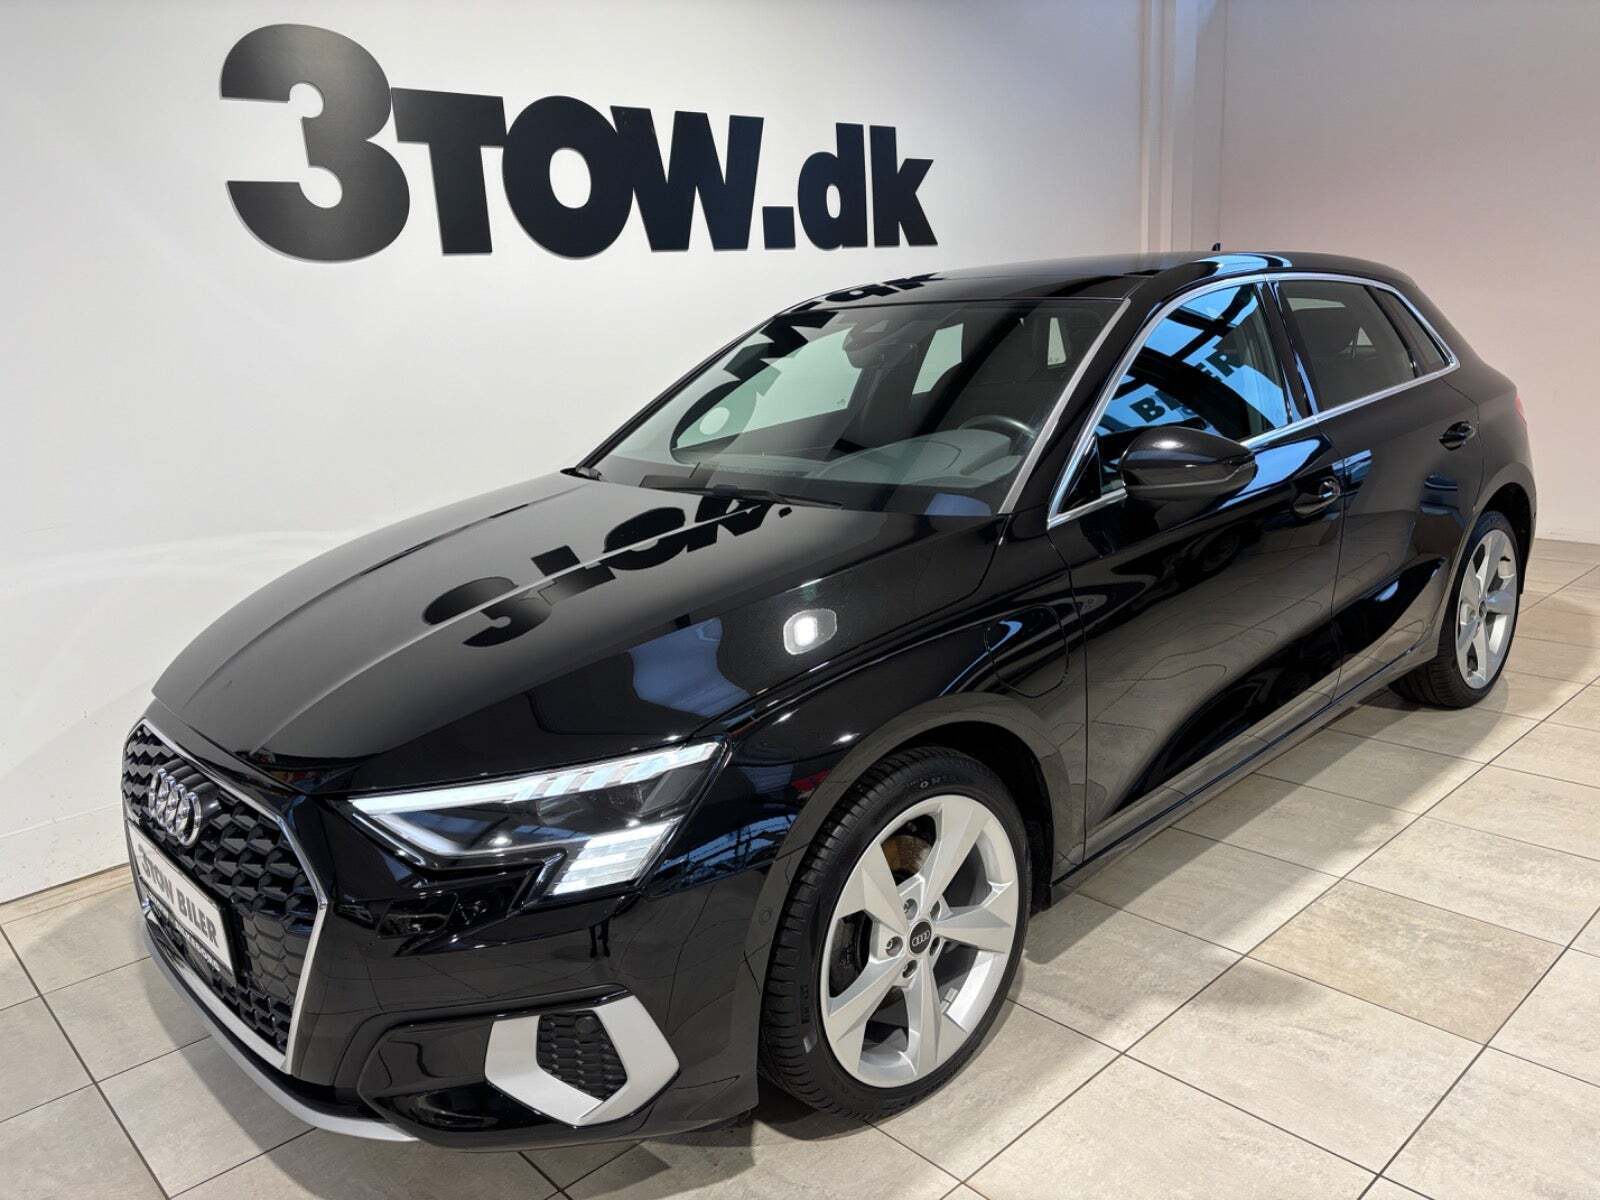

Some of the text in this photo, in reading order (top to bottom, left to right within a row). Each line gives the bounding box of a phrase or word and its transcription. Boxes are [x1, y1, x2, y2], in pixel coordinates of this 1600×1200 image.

[220, 23, 938, 263] 3TOW.dk
[137, 845, 175, 901] 3TOW
[176, 888, 220, 949] BILER
